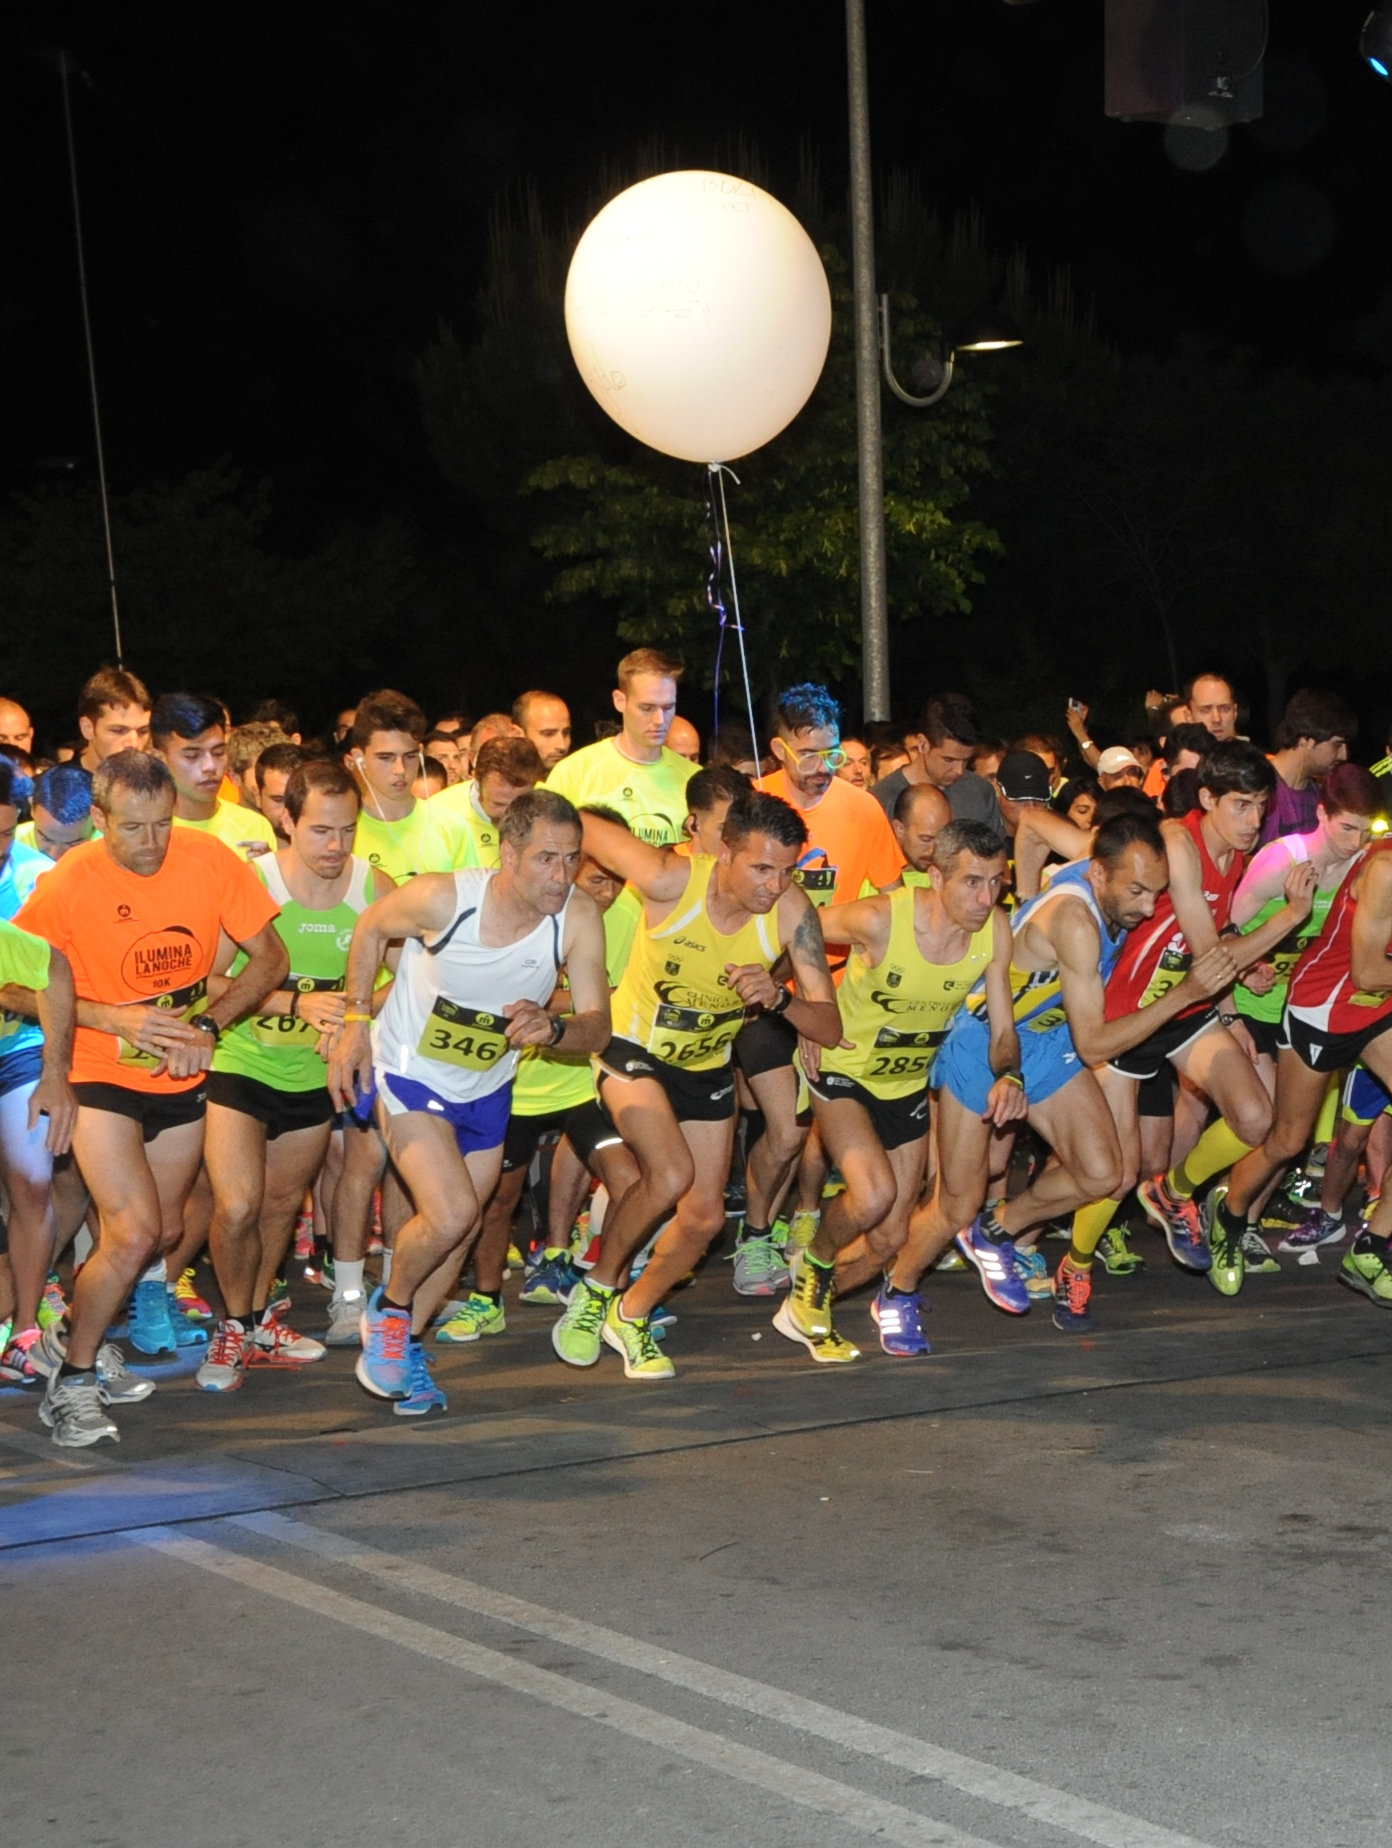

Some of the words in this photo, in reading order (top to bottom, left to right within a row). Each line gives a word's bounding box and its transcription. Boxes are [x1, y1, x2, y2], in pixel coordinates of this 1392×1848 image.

[134, 943, 193, 964] ILUMINA
[152, 957, 192, 973] NOCHE
[153, 977, 171, 988] 10K
[429, 1028, 499, 1061] 346
[660, 1031, 732, 1062] 2656
[870, 1055, 931, 1076] 285
